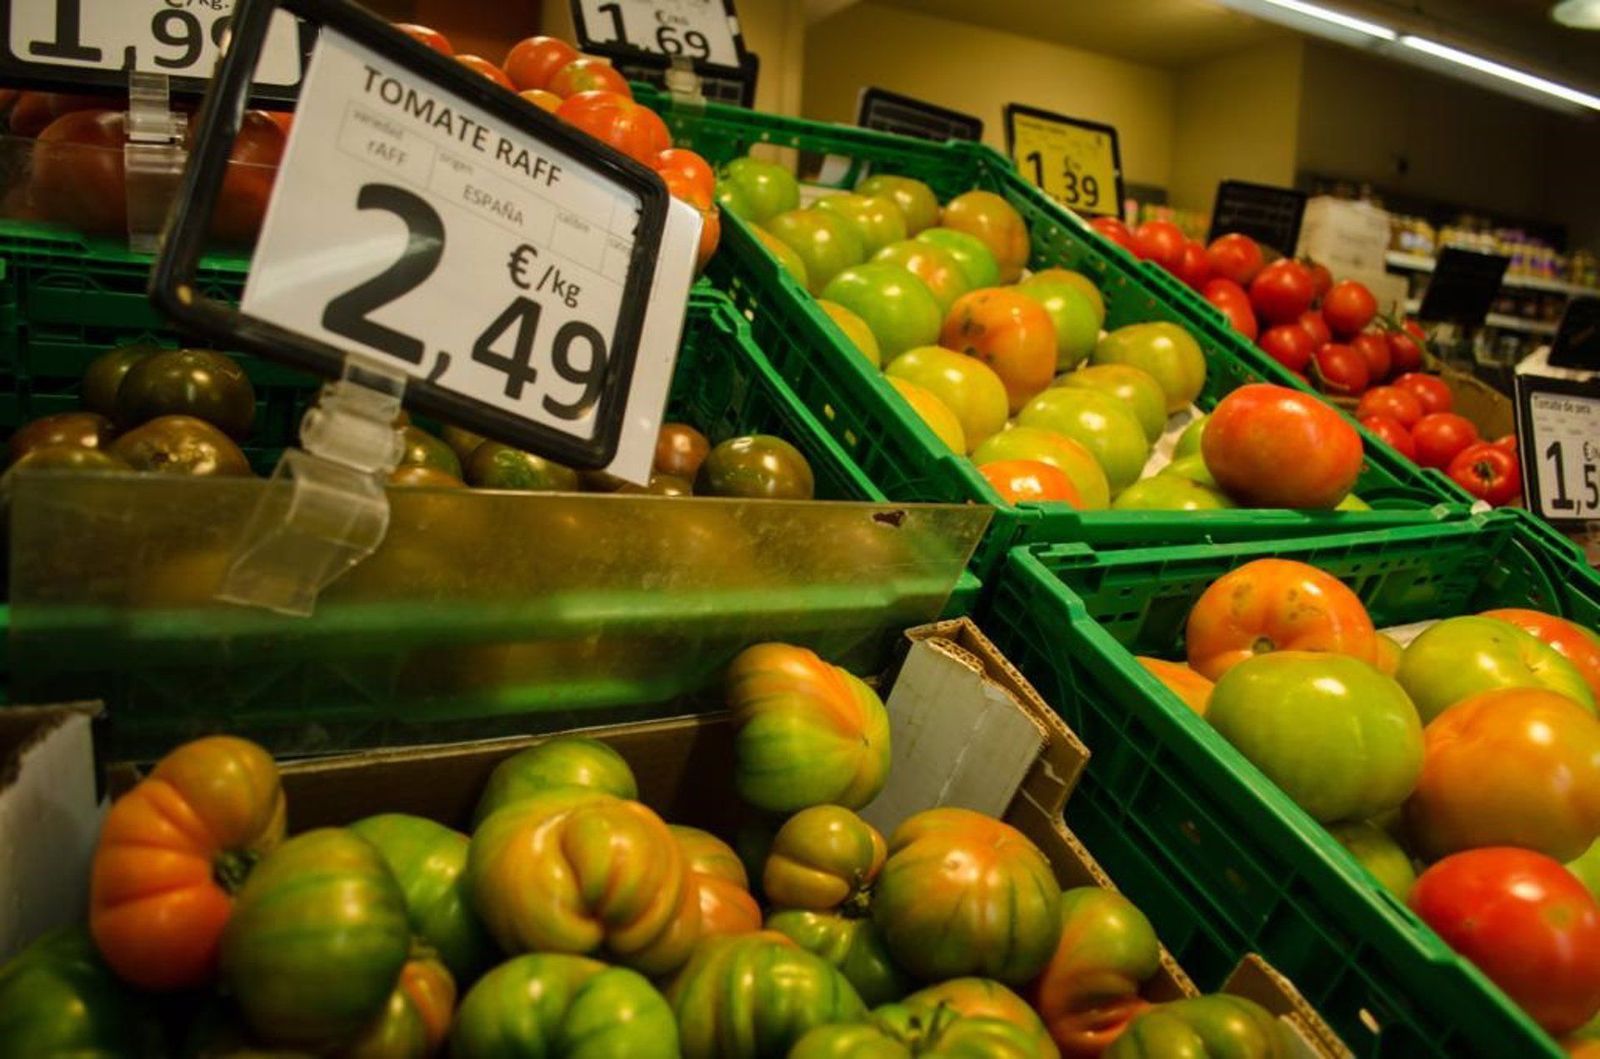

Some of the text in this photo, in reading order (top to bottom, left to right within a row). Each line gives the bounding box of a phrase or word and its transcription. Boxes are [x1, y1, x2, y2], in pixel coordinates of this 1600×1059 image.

[364, 65, 562, 187] TOMATE RAFF
[463, 184, 524, 226] ESPAÑA
[321, 182, 608, 420] 2,49
